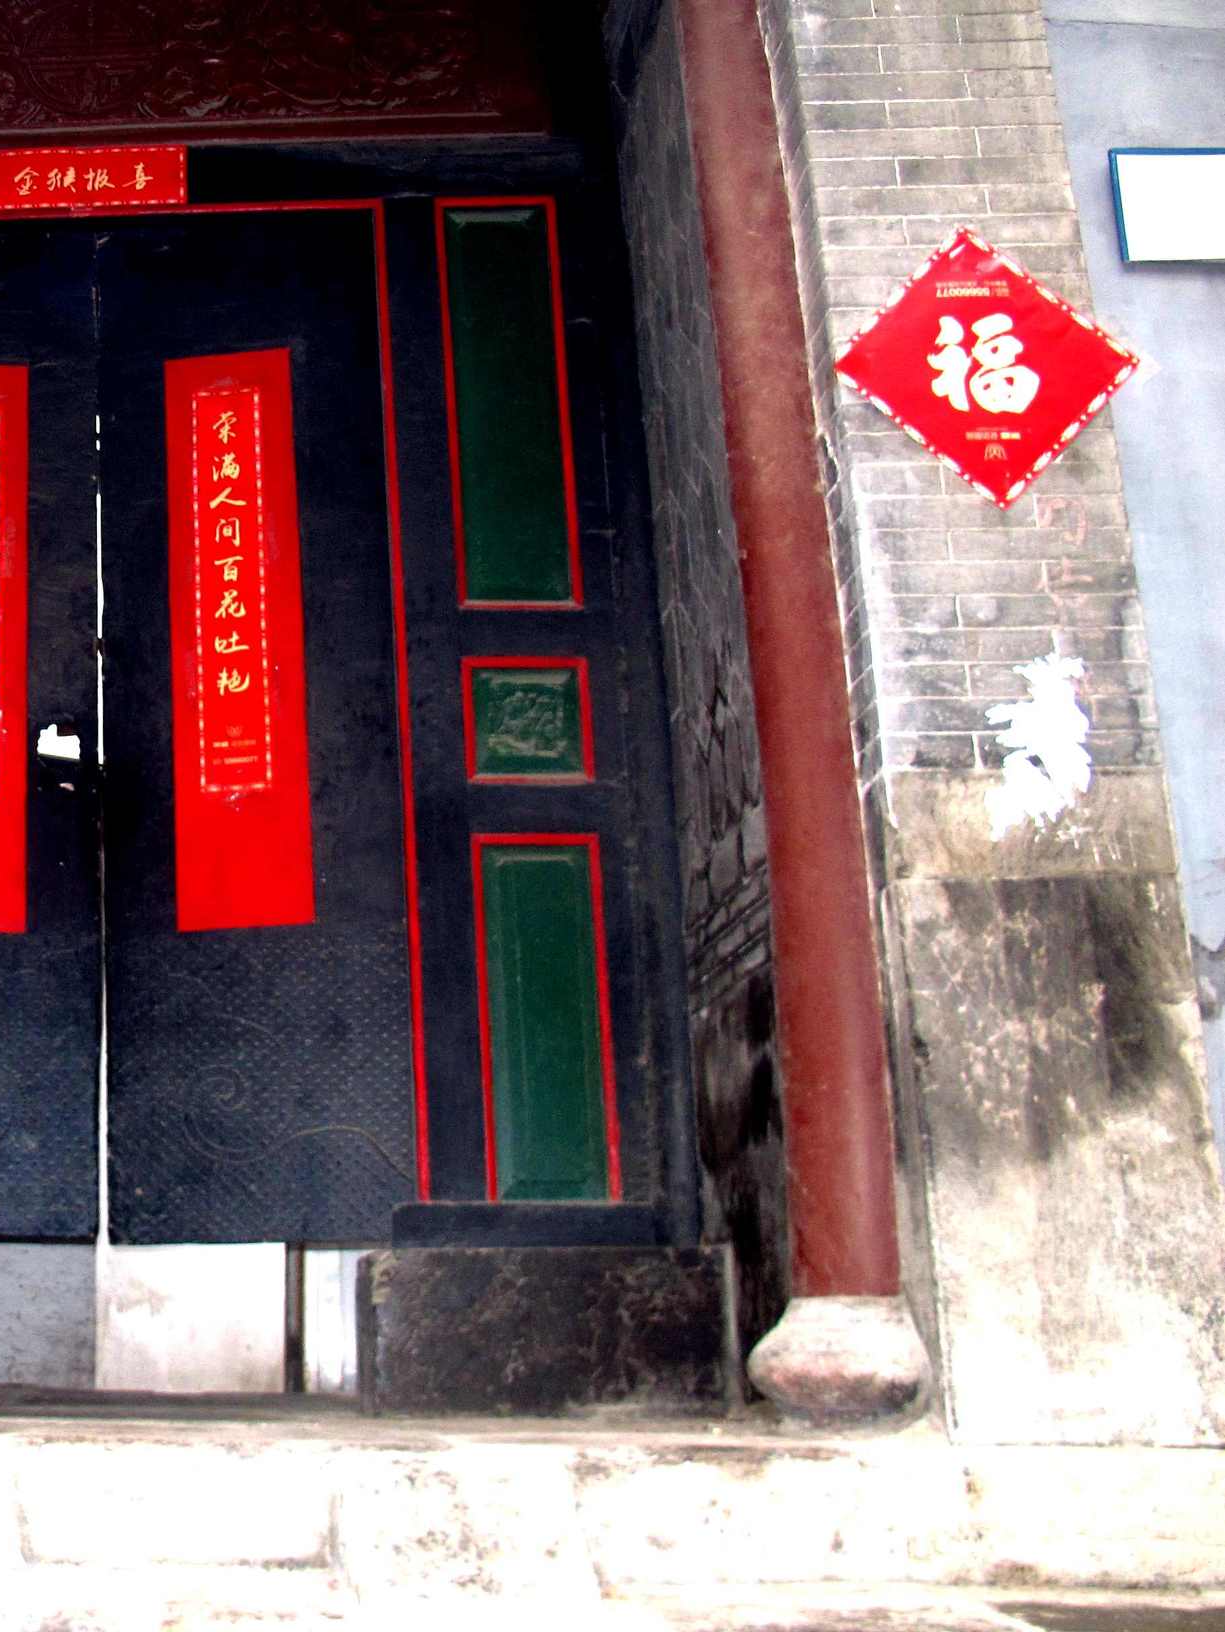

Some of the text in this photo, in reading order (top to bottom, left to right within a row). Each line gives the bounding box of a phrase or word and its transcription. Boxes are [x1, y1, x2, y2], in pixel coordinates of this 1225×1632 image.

[14, 162, 153, 195] 金猴报喜
[927, 313, 1041, 414] 福
